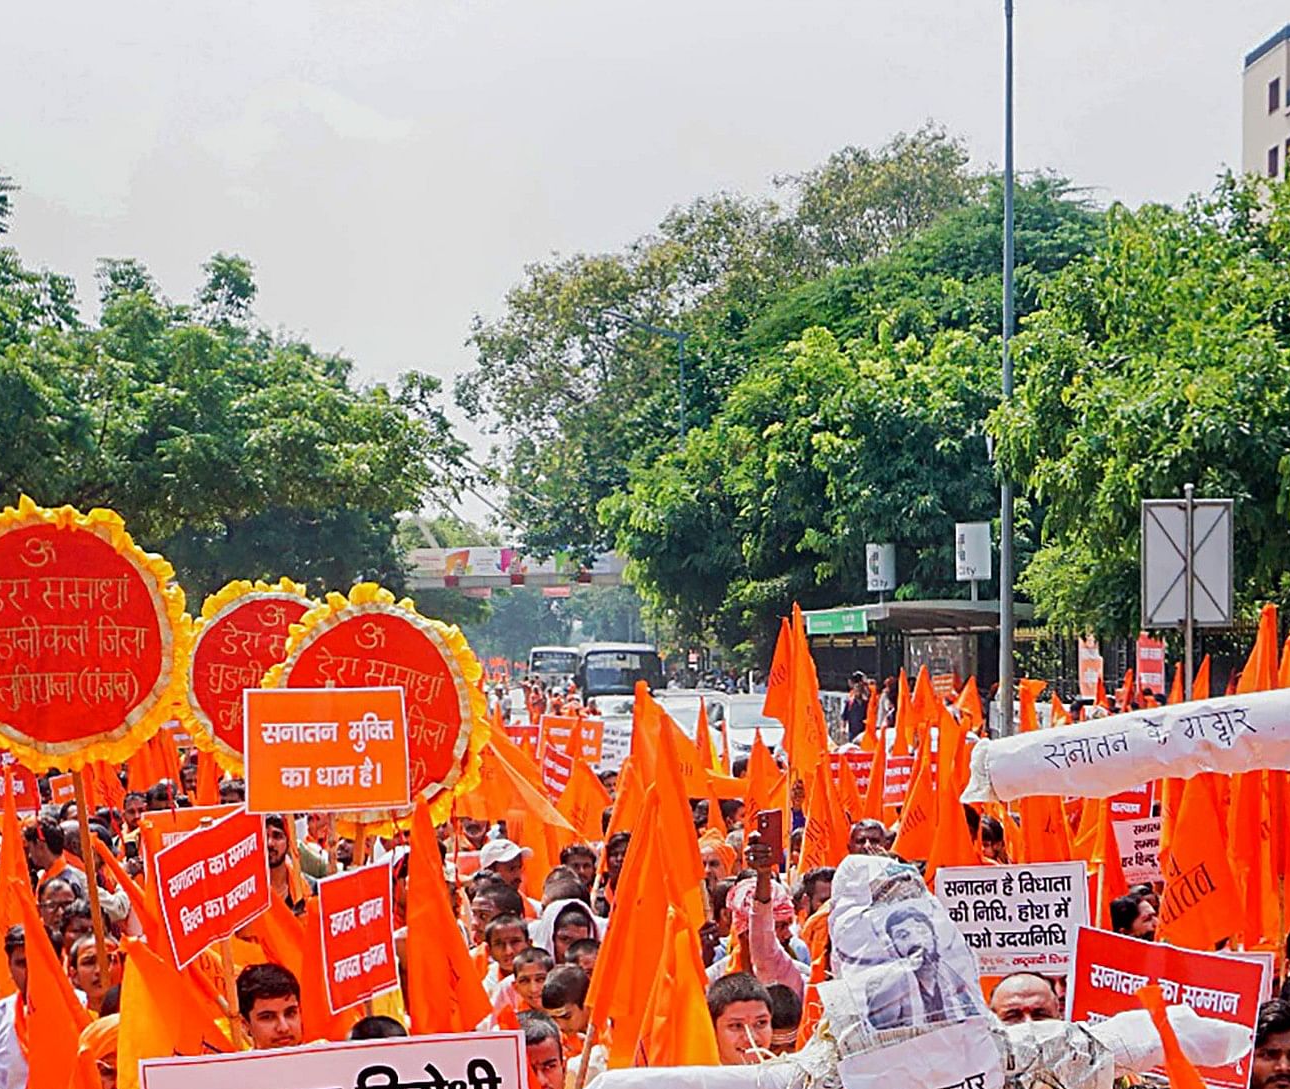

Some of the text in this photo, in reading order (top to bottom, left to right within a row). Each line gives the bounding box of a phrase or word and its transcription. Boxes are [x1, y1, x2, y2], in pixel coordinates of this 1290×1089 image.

[261, 712, 394, 752] सनातन मुक्ति
[281, 766, 311, 788] का
[316, 764, 354, 787] धाम
[944, 871, 1072, 899] सनातन है विधाता
[949, 899, 970, 923] की
[1017, 899, 1050, 922] होश
[1054, 896, 1070, 919] में
[996, 923, 1066, 948] उदयनिधि
[1091, 963, 1149, 996] सनातन
[1181, 983, 1241, 1016] सम्मान
